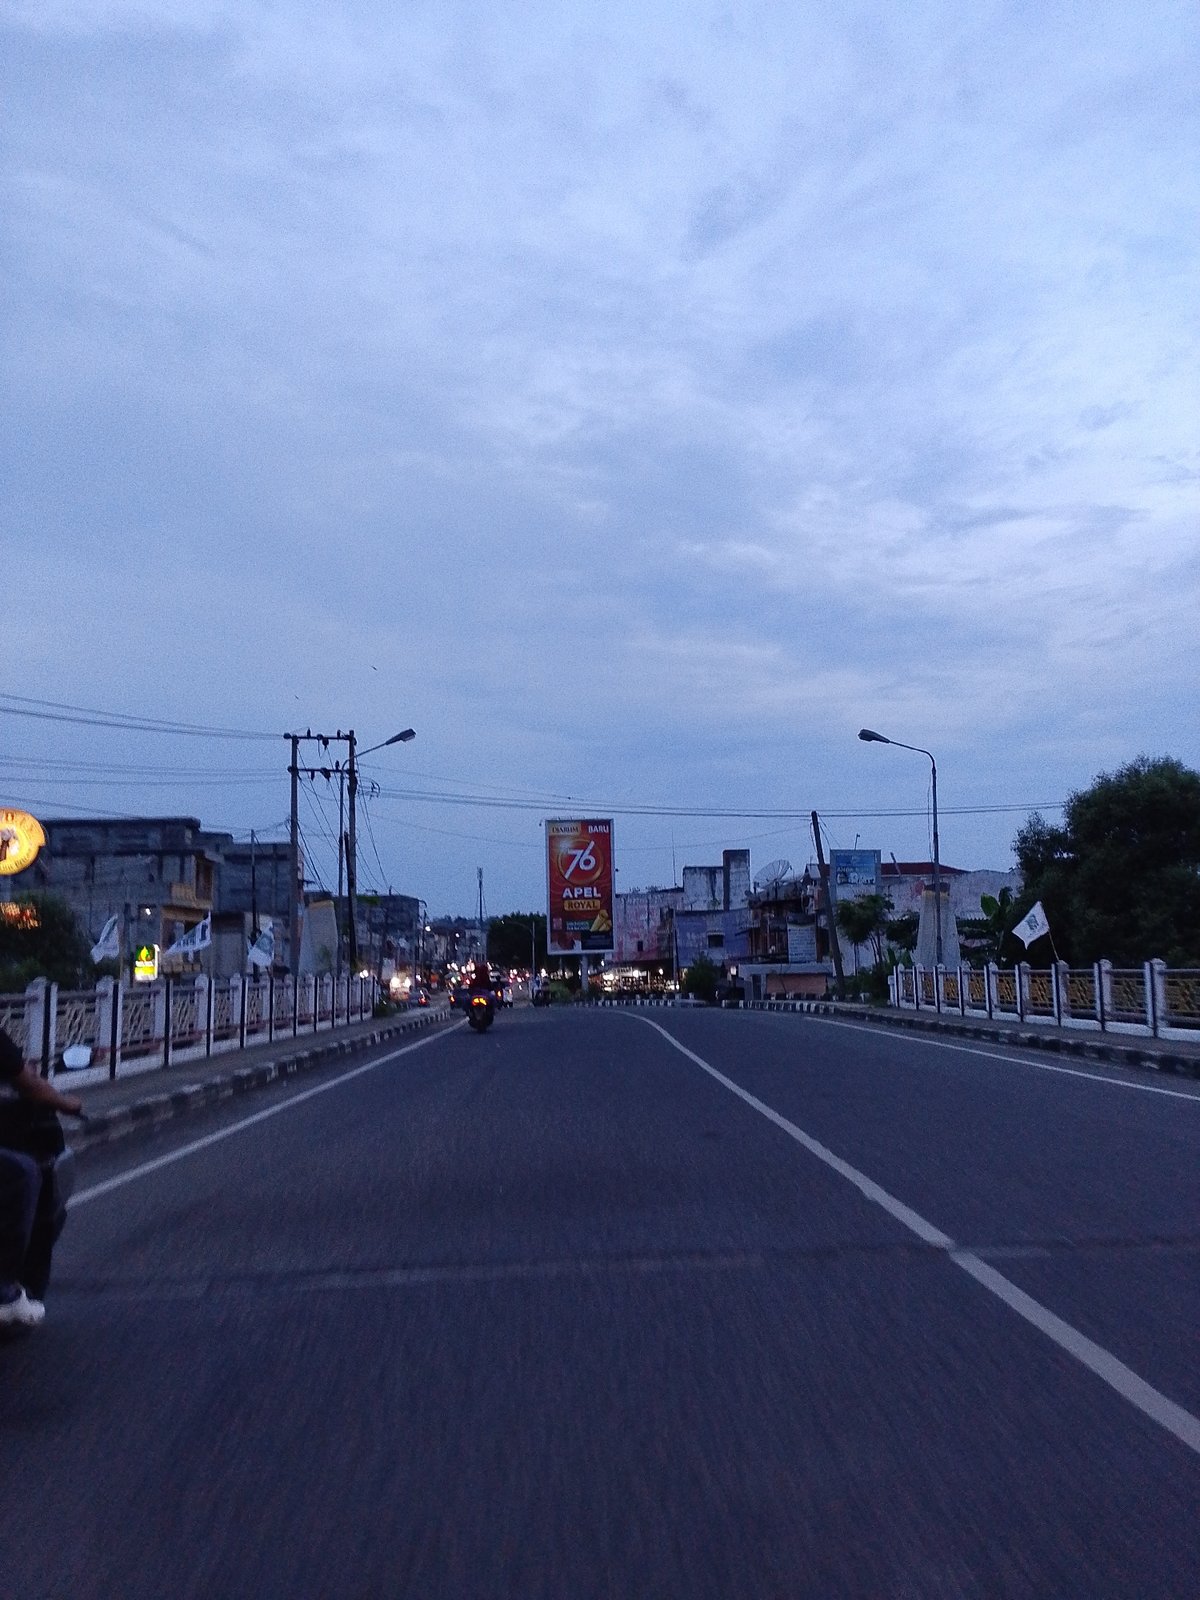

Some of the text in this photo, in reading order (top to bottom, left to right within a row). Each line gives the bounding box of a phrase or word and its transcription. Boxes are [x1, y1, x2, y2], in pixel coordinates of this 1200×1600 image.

[588, 824, 609, 833] BARU
[564, 840, 596, 880] 76
[562, 887, 602, 899] APEL
[567, 900, 598, 909] ROYAL
